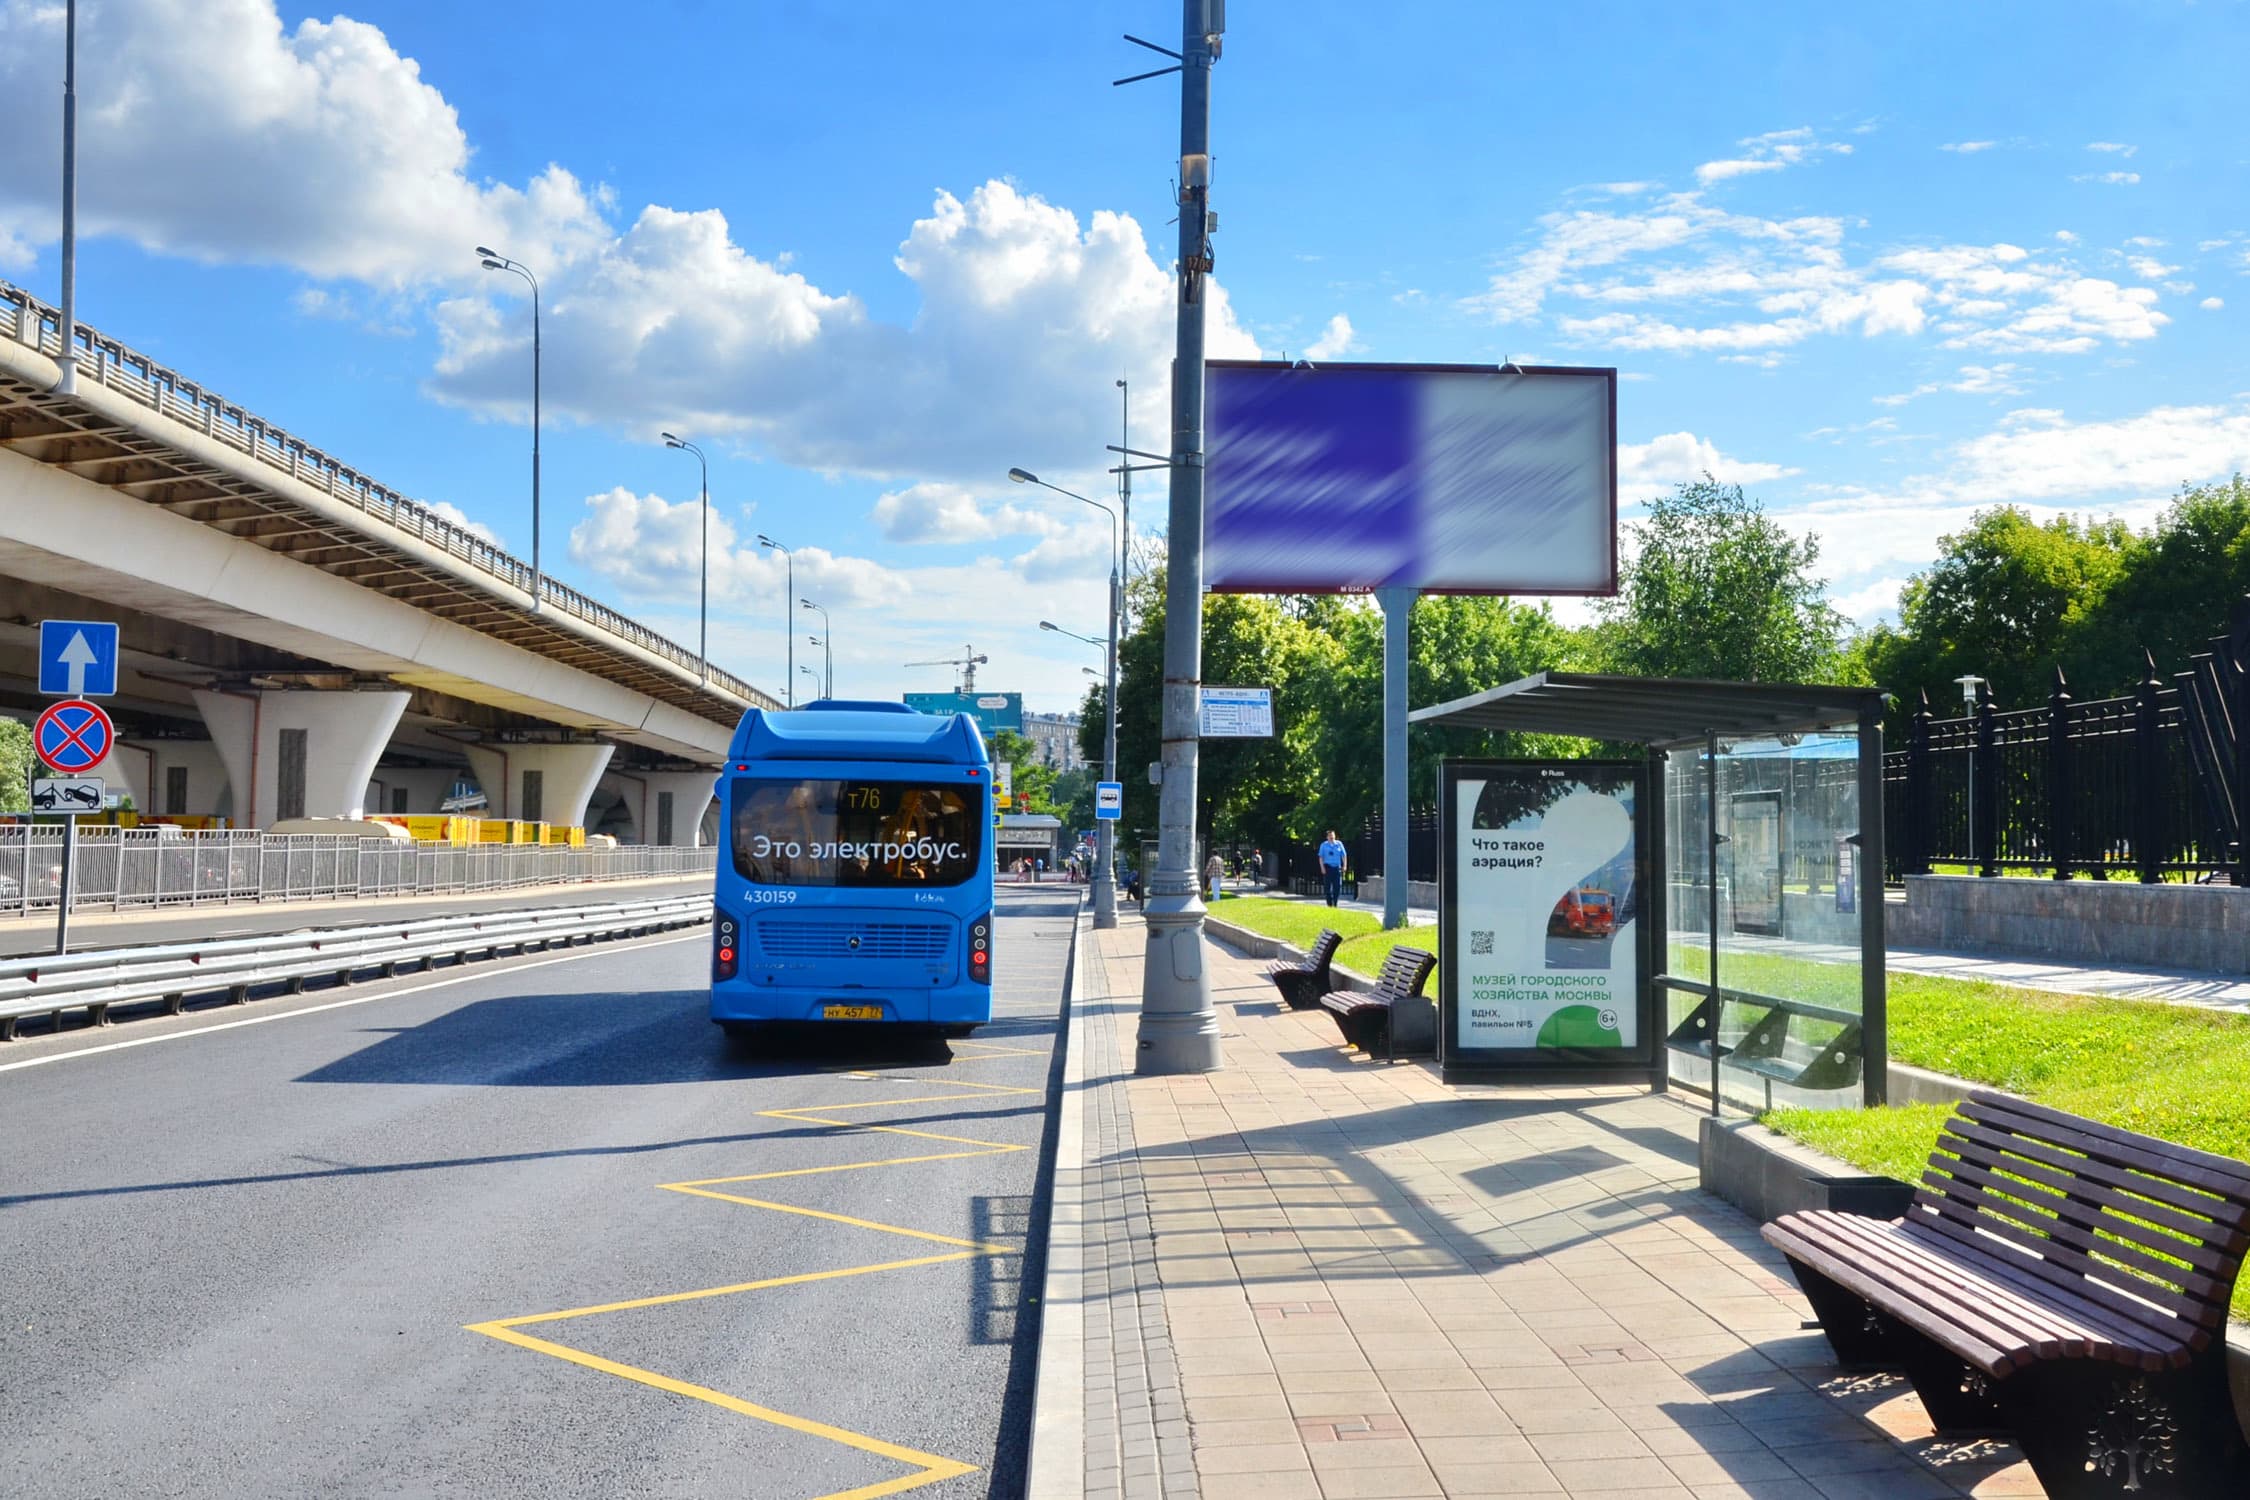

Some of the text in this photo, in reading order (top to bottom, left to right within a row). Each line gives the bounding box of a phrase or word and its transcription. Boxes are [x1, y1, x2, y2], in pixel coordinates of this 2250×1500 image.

[753, 836, 968, 864] Это электробус.
[1472, 838, 1544, 851] Что такое
[1472, 855, 1543, 870] аэрация?
[744, 890, 797, 904] 430159
[1472, 974, 1606, 988] МУЗЕЙ ГОРОДСКОГО
[1472, 988, 1612, 1001] ХОЗЯЙСТВА МОСКВЫ
[1472, 1008, 1500, 1018] ВДНХ,
[1601, 1014, 1616, 1023] 6+
[1472, 1020, 1514, 1029] павильон
